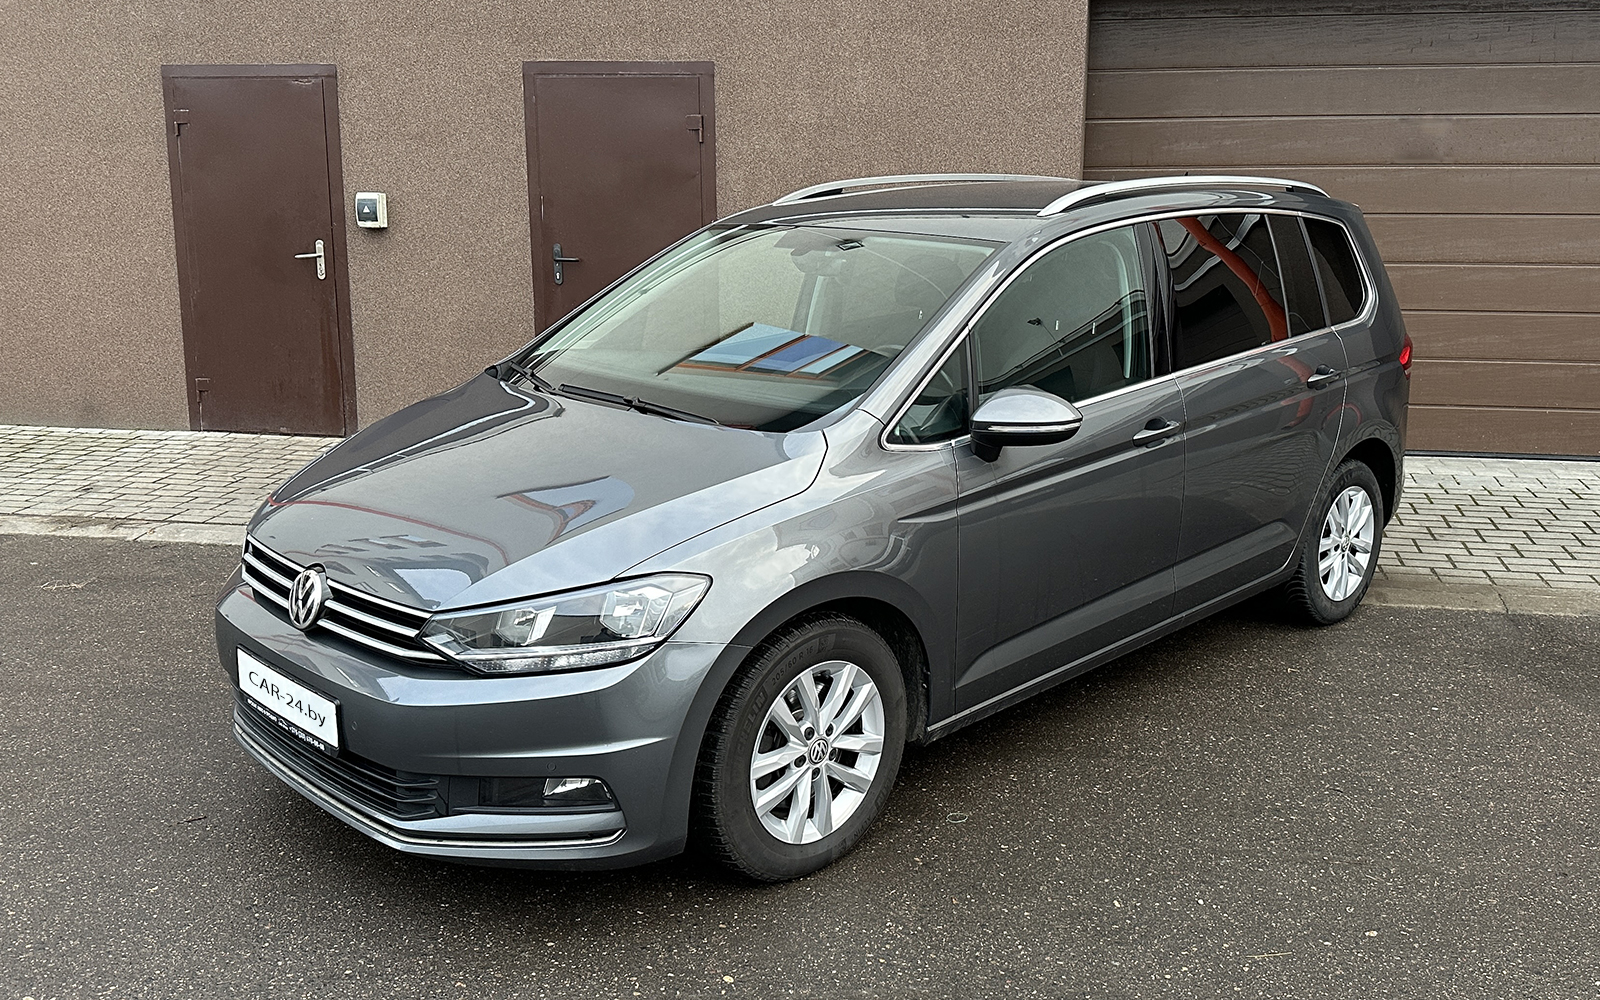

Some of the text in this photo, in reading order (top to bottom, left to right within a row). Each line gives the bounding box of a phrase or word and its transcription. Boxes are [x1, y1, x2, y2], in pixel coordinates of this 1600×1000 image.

[248, 671, 326, 727] CAR-24.by
[771, 656, 798, 686] 205/60
[733, 691, 768, 776] CHELIN
